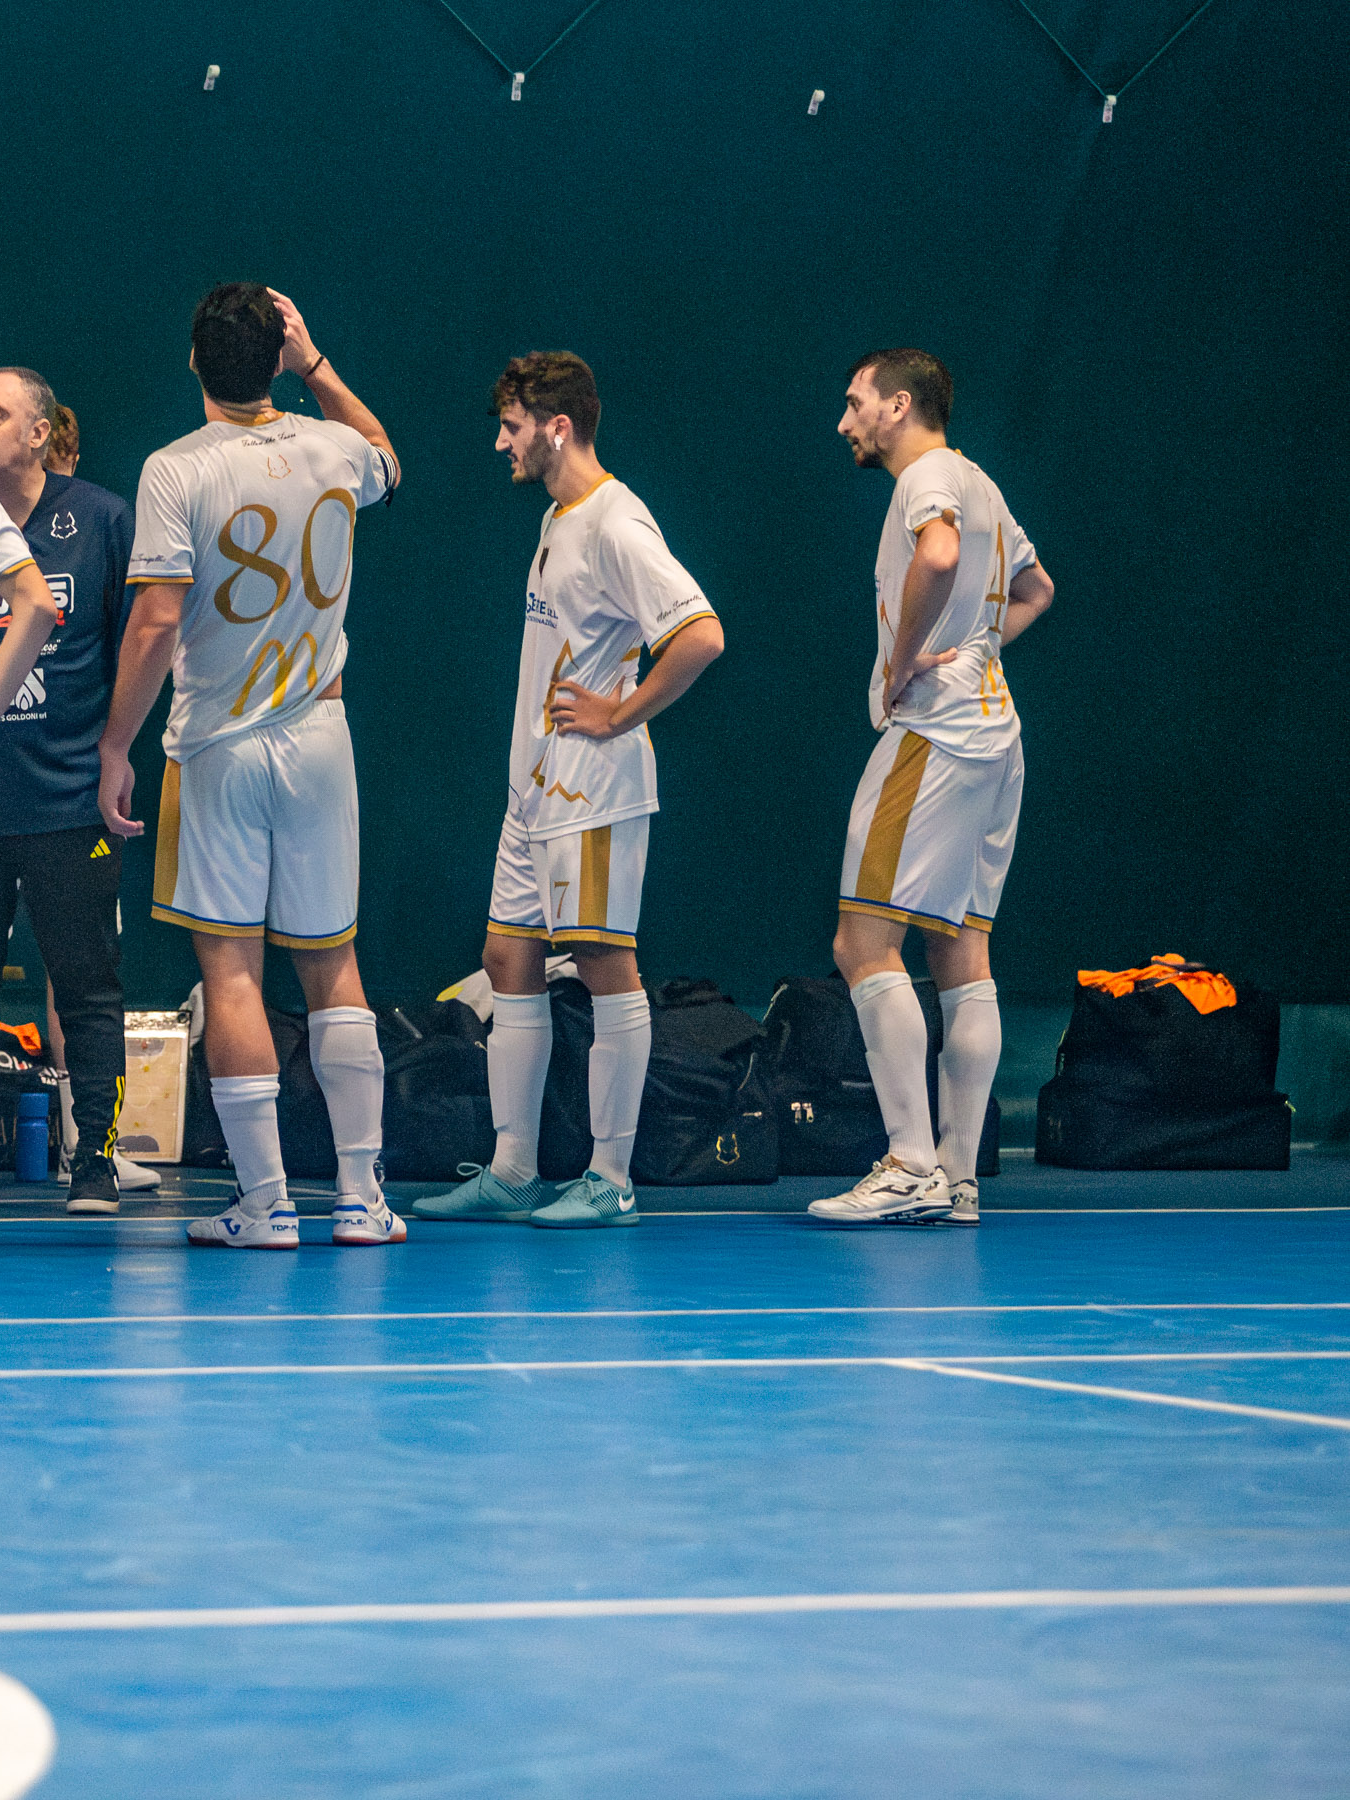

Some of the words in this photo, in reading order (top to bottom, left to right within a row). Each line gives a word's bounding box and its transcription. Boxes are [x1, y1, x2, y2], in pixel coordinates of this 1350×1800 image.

[213, 487, 356, 625] 80
[6, 713, 38, 721] GOLDONI
[554, 881, 569, 919] 7
